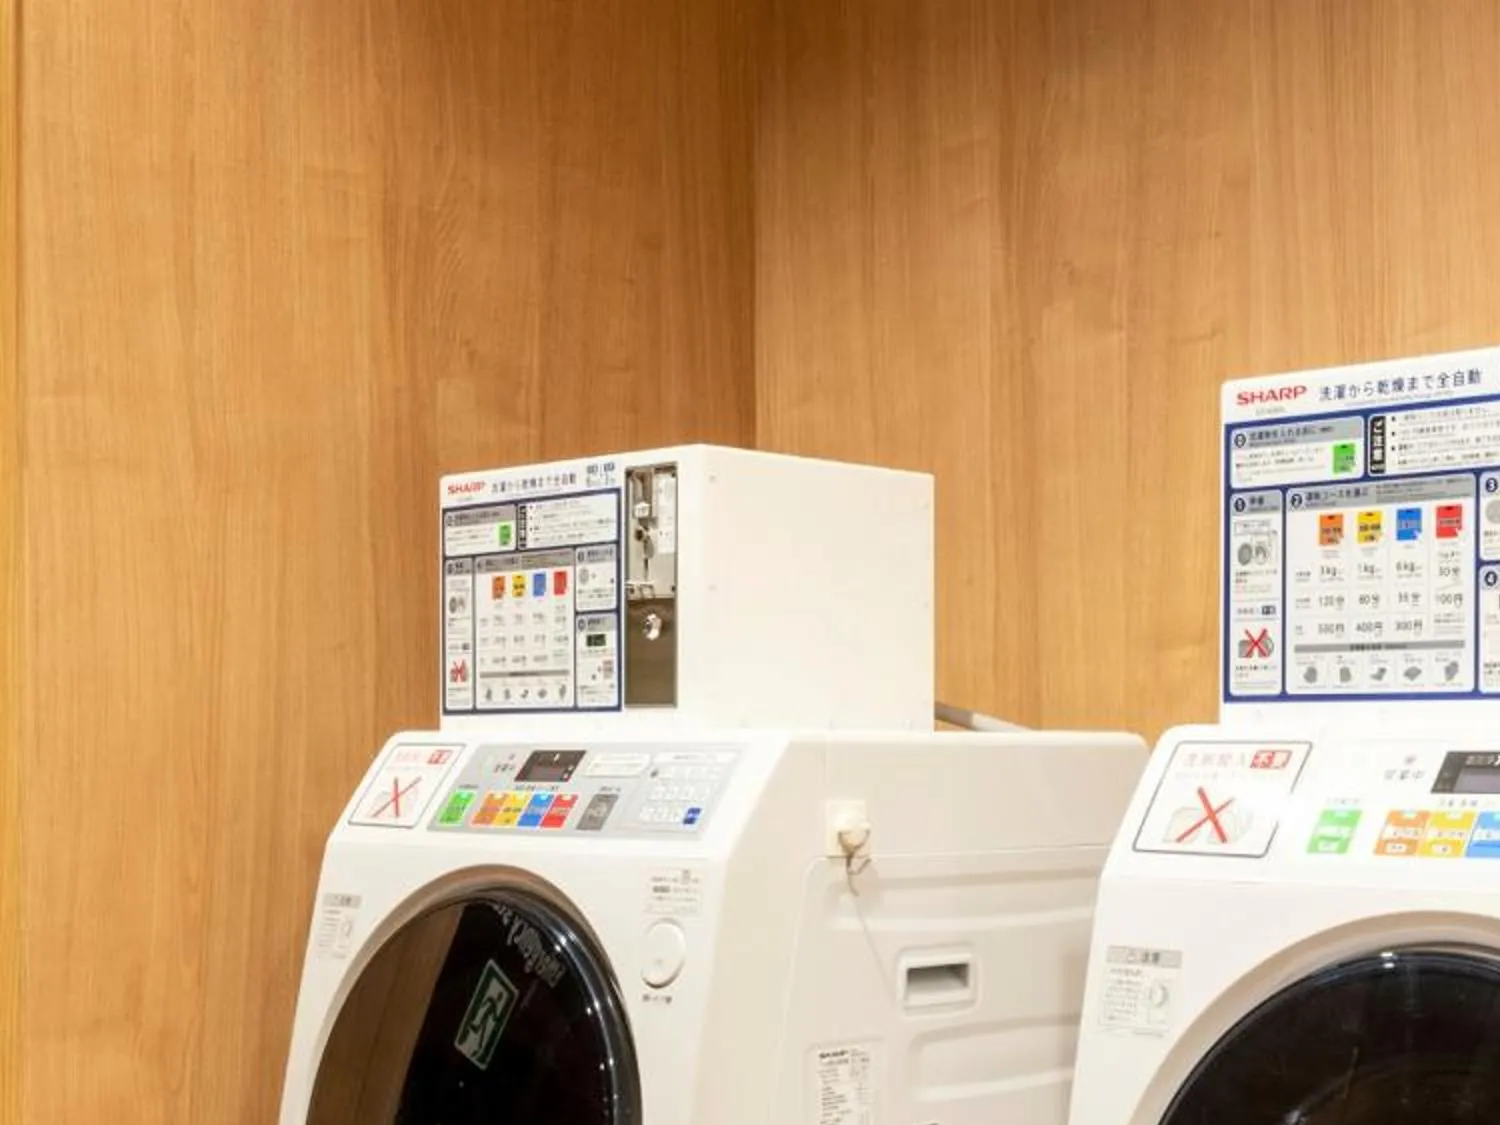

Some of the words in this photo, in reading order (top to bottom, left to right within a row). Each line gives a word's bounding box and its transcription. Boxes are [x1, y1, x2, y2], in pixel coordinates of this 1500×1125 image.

[1237, 384, 1308, 407] SHARP
[1318, 368, 1483, 402] 洗濯から乾燥まで全自動
